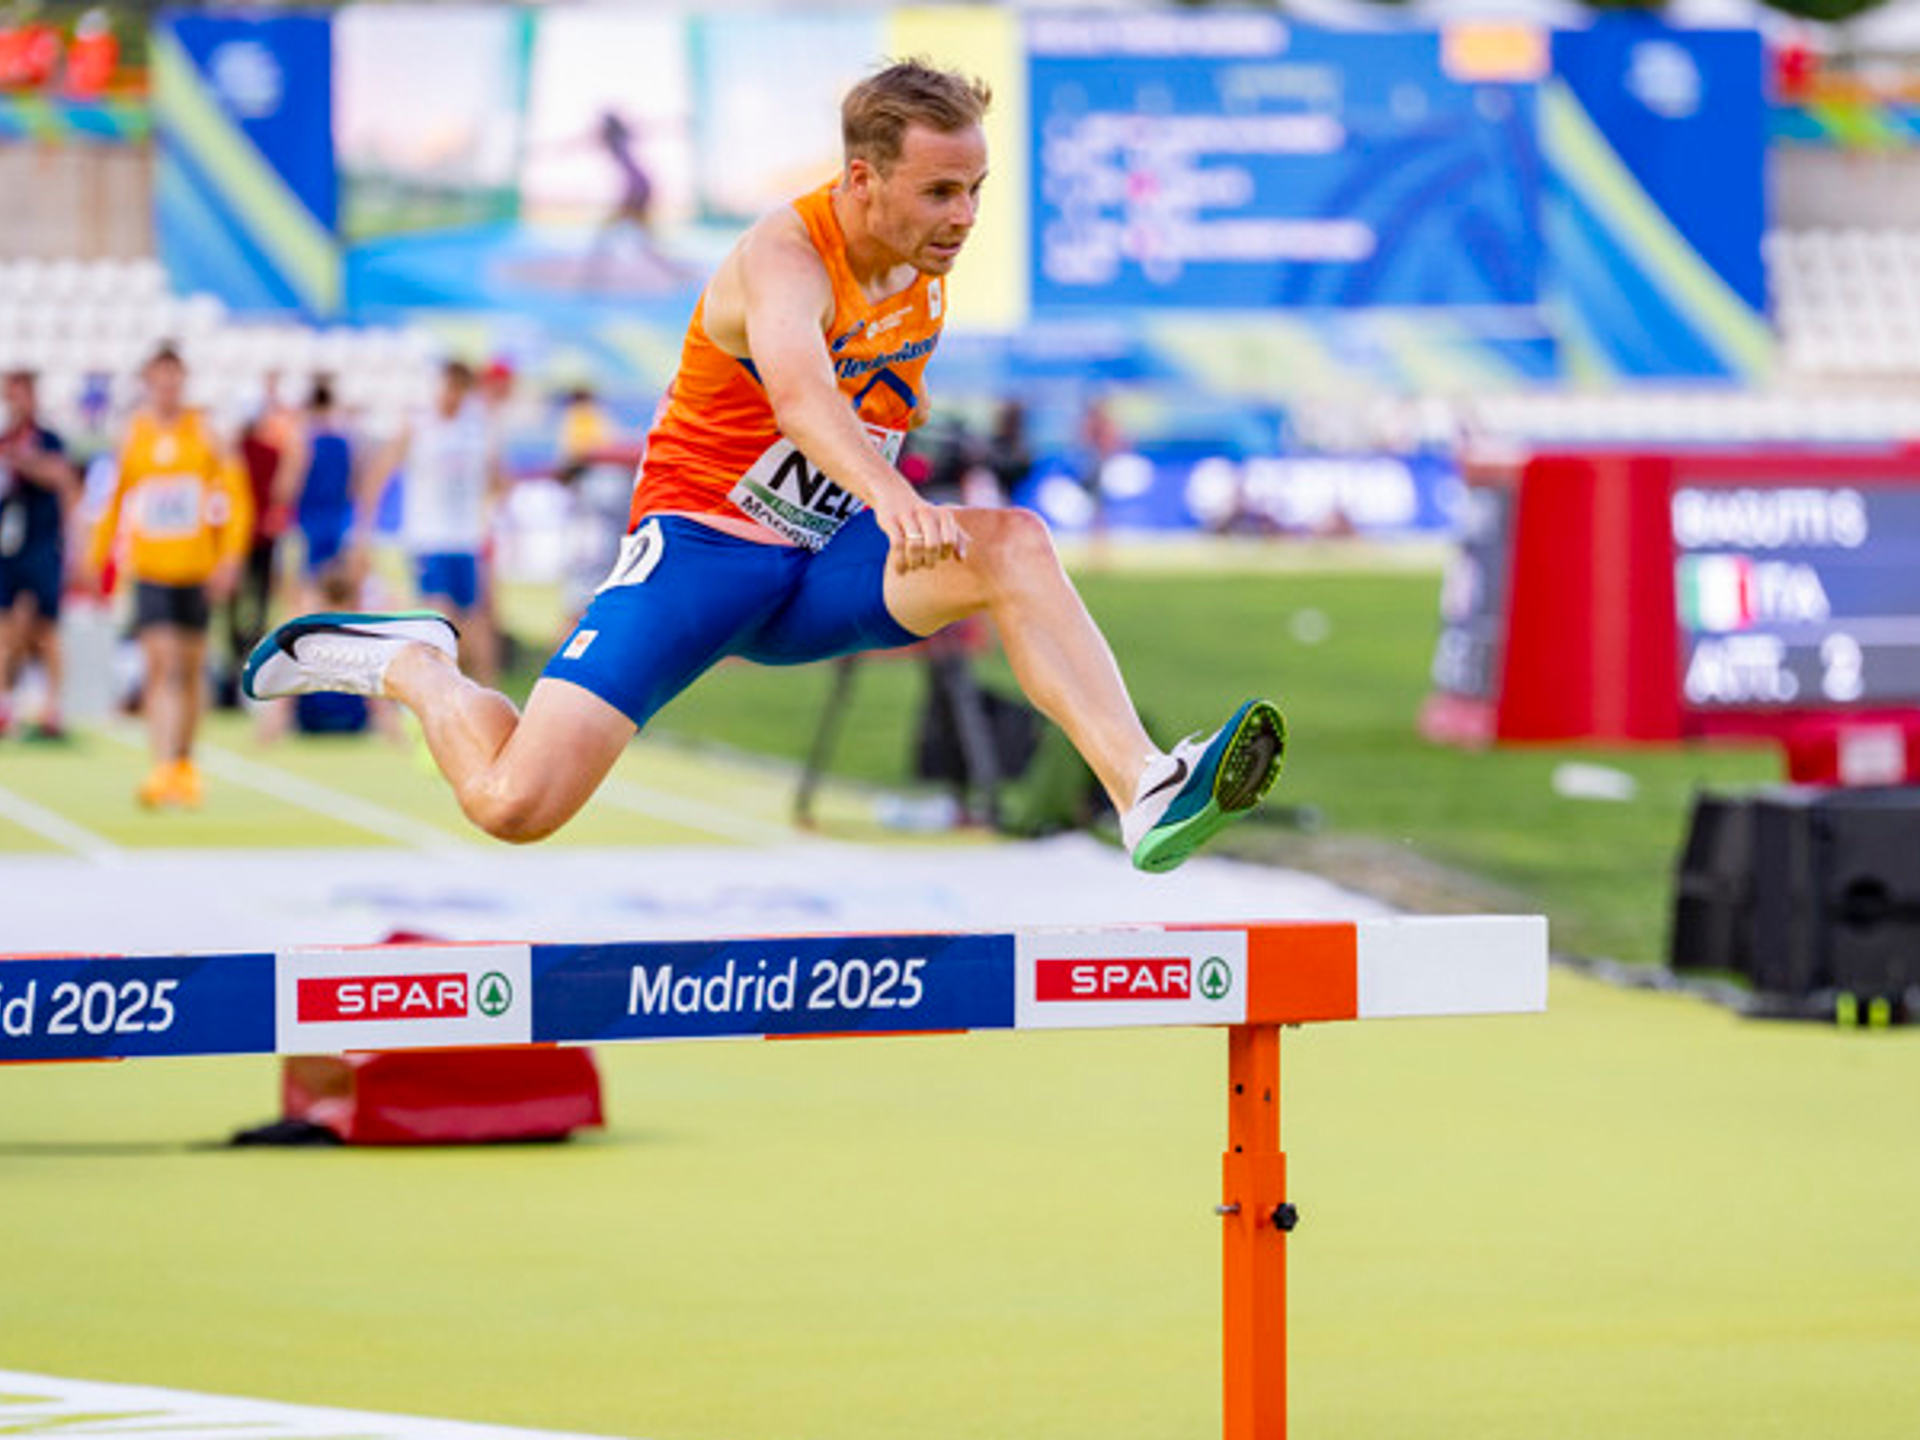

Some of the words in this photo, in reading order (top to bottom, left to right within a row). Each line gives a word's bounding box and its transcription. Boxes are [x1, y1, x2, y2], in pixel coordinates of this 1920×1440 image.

[336, 980, 467, 1014] SPAR
[627, 958, 798, 1016] Madrid
[806, 957, 927, 1010] 2025
[1070, 963, 1189, 993] SPAR
[47, 979, 179, 1035] 2025
